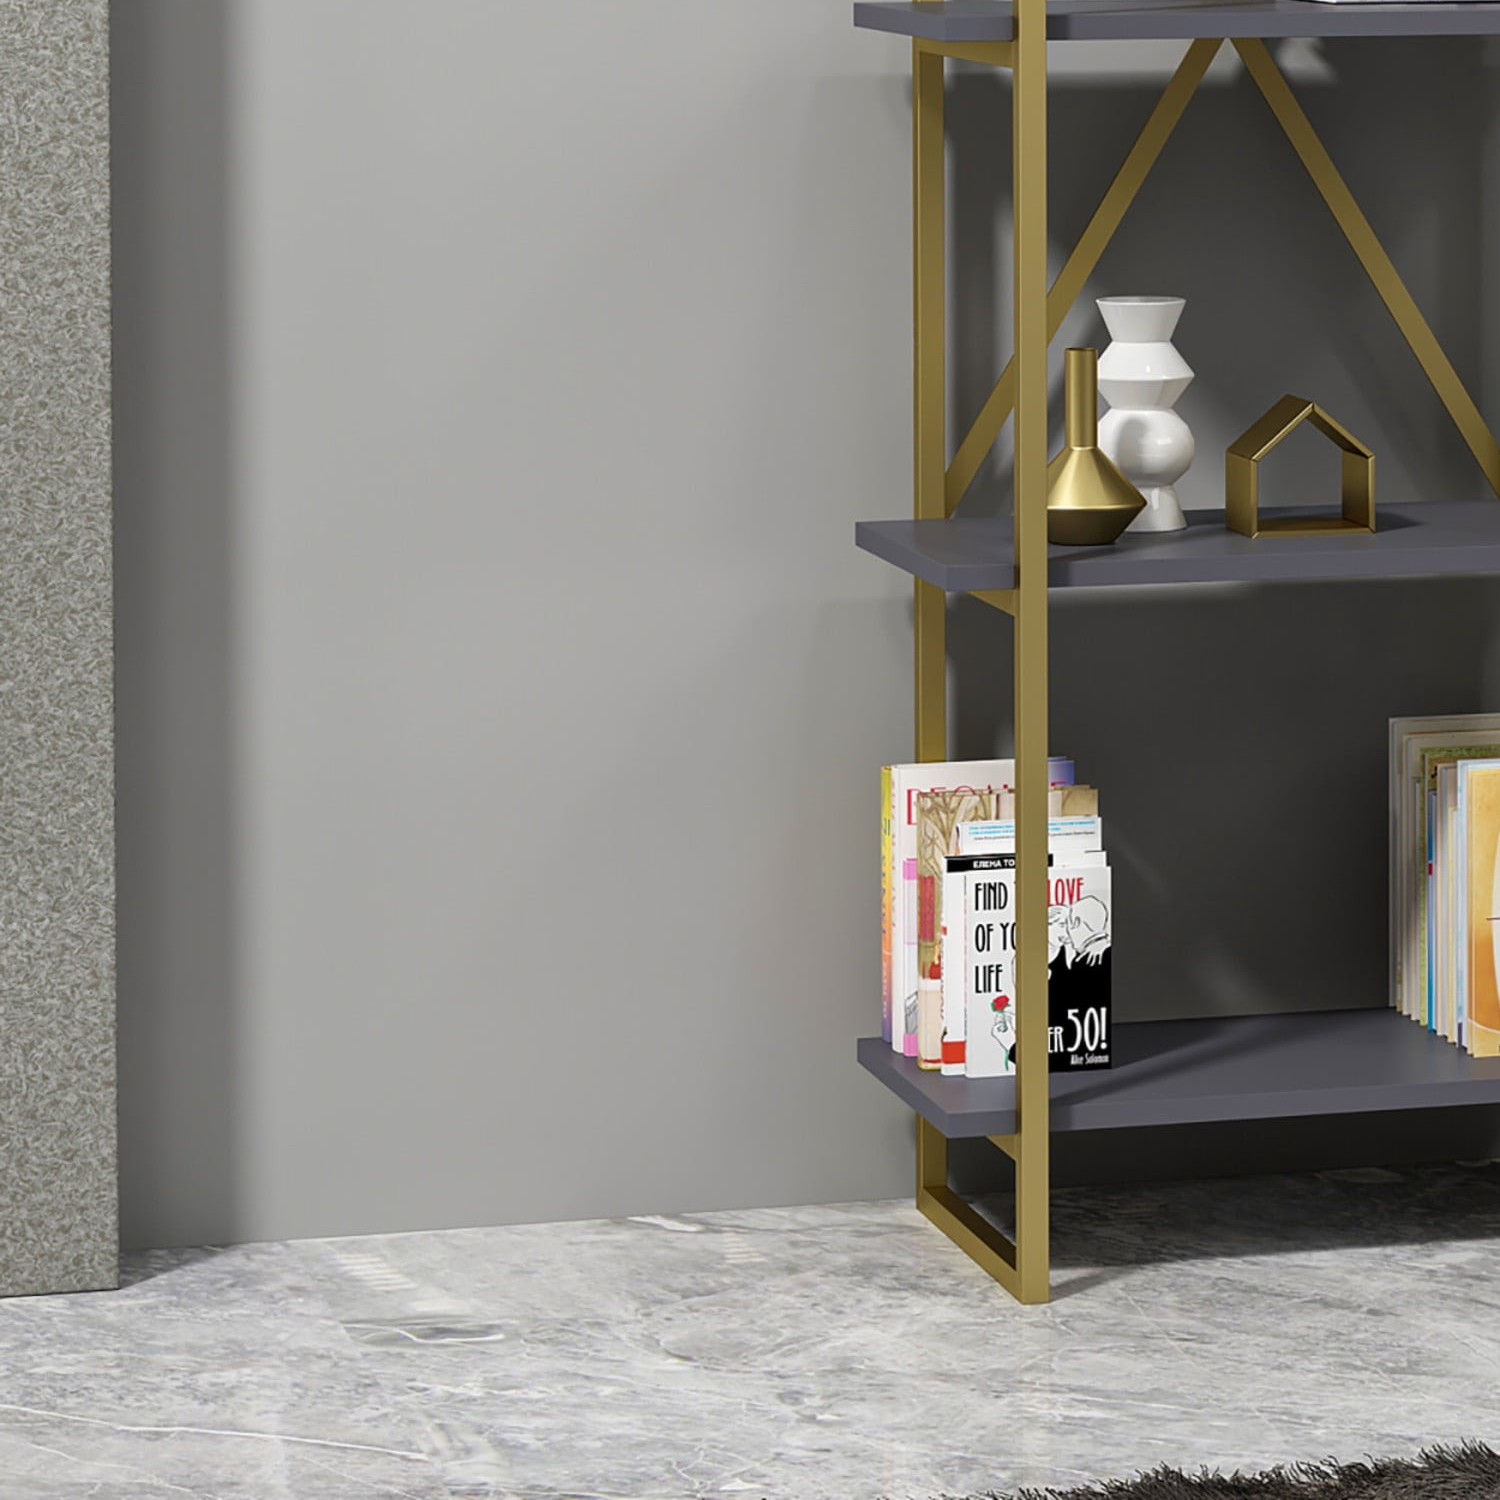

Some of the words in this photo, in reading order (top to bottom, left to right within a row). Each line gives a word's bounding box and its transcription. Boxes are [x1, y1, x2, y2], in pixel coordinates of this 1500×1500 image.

[974, 881, 1009, 912] FIND
[974, 923, 995, 953] OF
[974, 964, 1004, 994] LIFE
[1067, 1006, 1107, 1052] 50!
